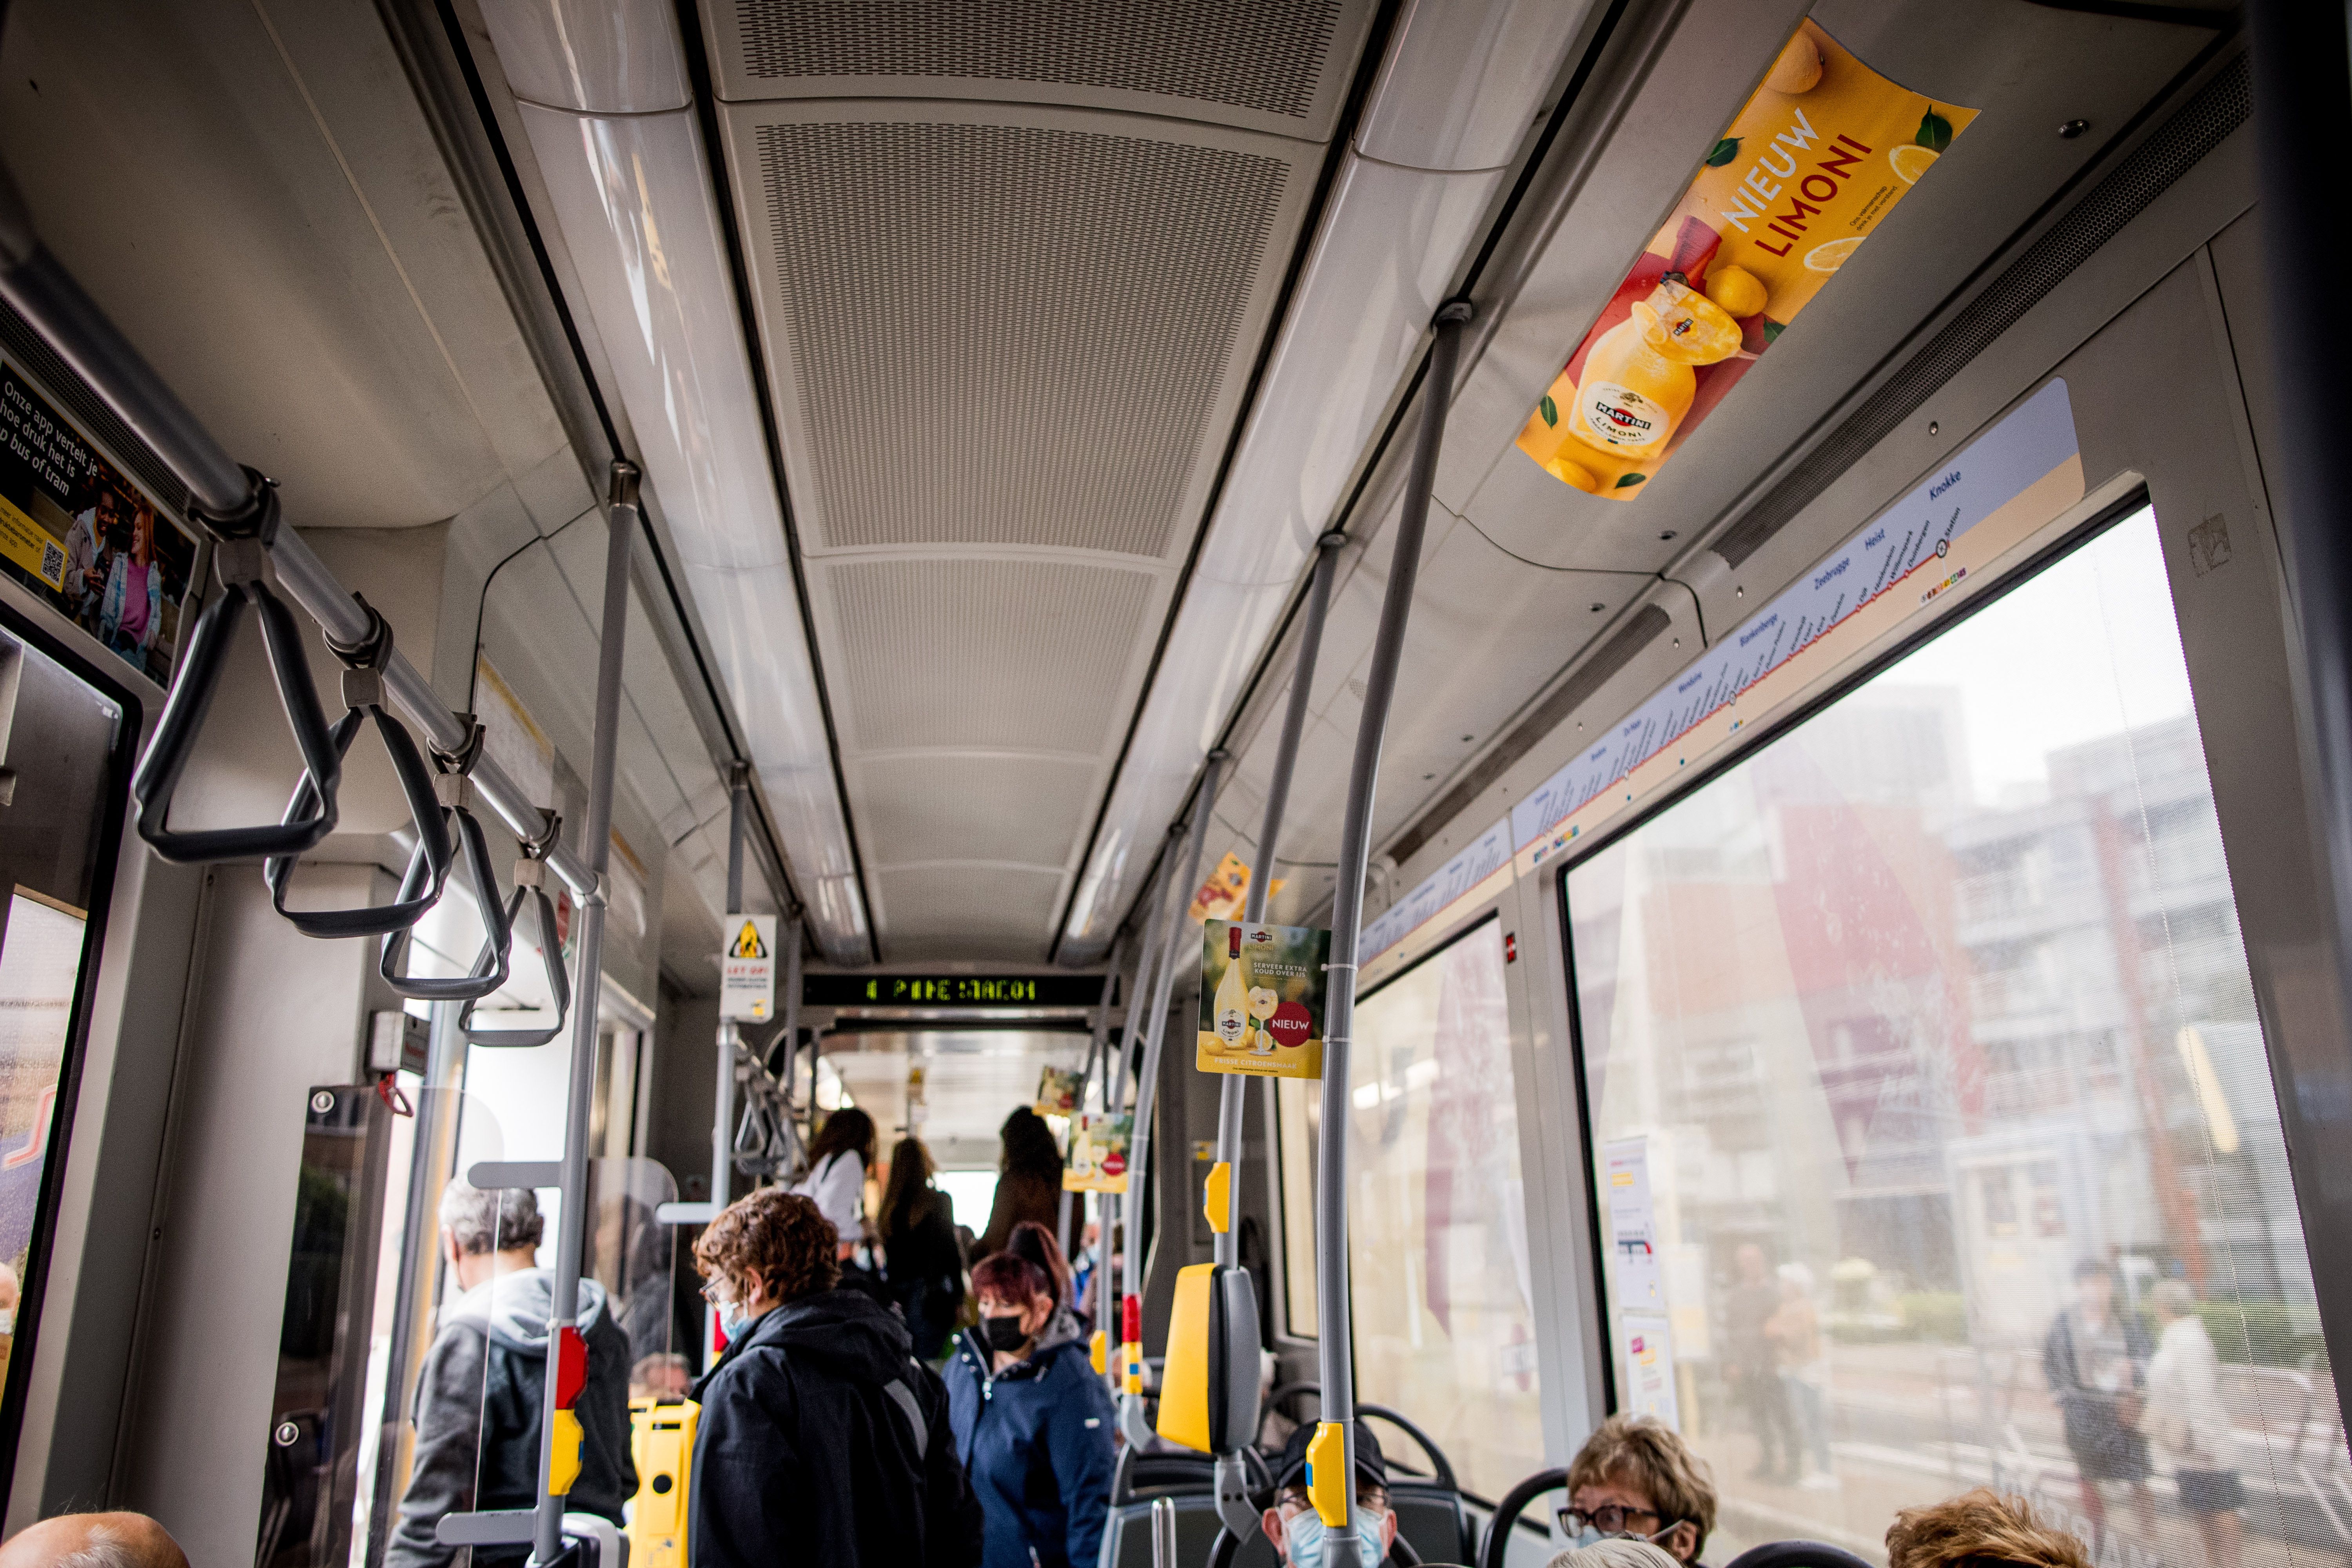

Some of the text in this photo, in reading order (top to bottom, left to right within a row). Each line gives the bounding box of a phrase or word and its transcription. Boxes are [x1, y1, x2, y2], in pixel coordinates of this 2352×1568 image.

[1720, 107, 1819, 233] NIEUW
[1754, 134, 1873, 257] LIMONI
[1849, 186, 1887, 226] Ons vakmanschap
[1674, 319, 1693, 335] MARTINI
[5, 381, 98, 477] Onze app vertelt je
[1595, 416, 1641, 437] LIMONI
[1598, 403, 1649, 429] MARTINI
[0, 398, 76, 477] hoe druk het is
[0, 425, 69, 496] p bus of tram
[1929, 471, 1961, 501] Knokke
[1945, 506, 1960, 537] Station
[1864, 528, 1885, 551] Heist
[1890, 530, 1913, 579] Willemspark
[1907, 519, 1930, 567] Duinbergen
[1814, 557, 1850, 590] Zeebrugge
[1272, 1019, 1309, 1030] NIEUW
[1240, 1059, 1298, 1069] CITROENSMAAK
